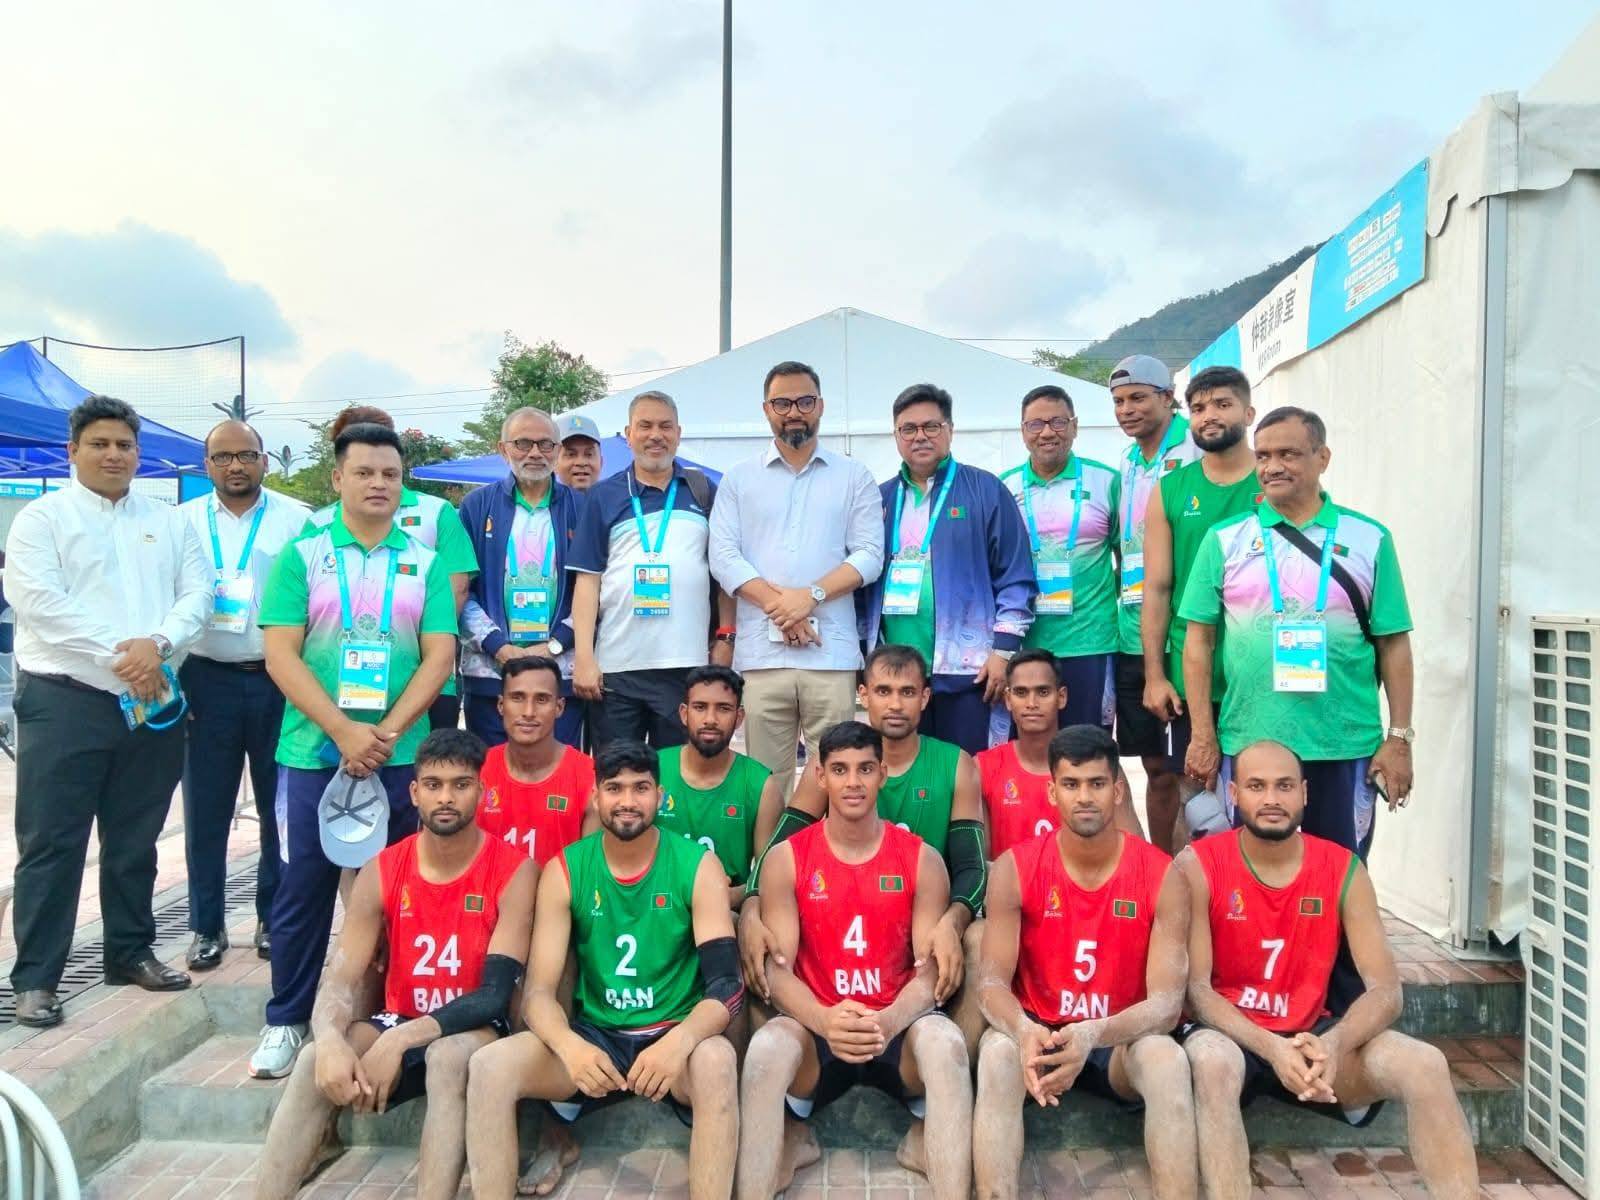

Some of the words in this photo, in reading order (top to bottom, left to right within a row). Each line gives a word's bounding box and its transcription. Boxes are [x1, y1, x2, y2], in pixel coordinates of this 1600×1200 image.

[412, 934, 462, 976] 24
[615, 933, 637, 977] 2
[843, 914, 868, 957] 4
[1073, 939, 1098, 983] 5
[1261, 938, 1285, 980] 7
[605, 986, 654, 1010] BAN
[834, 967, 882, 996] BAN
[1238, 985, 1290, 1018] BAN
[1058, 989, 1110, 1019] BAN
